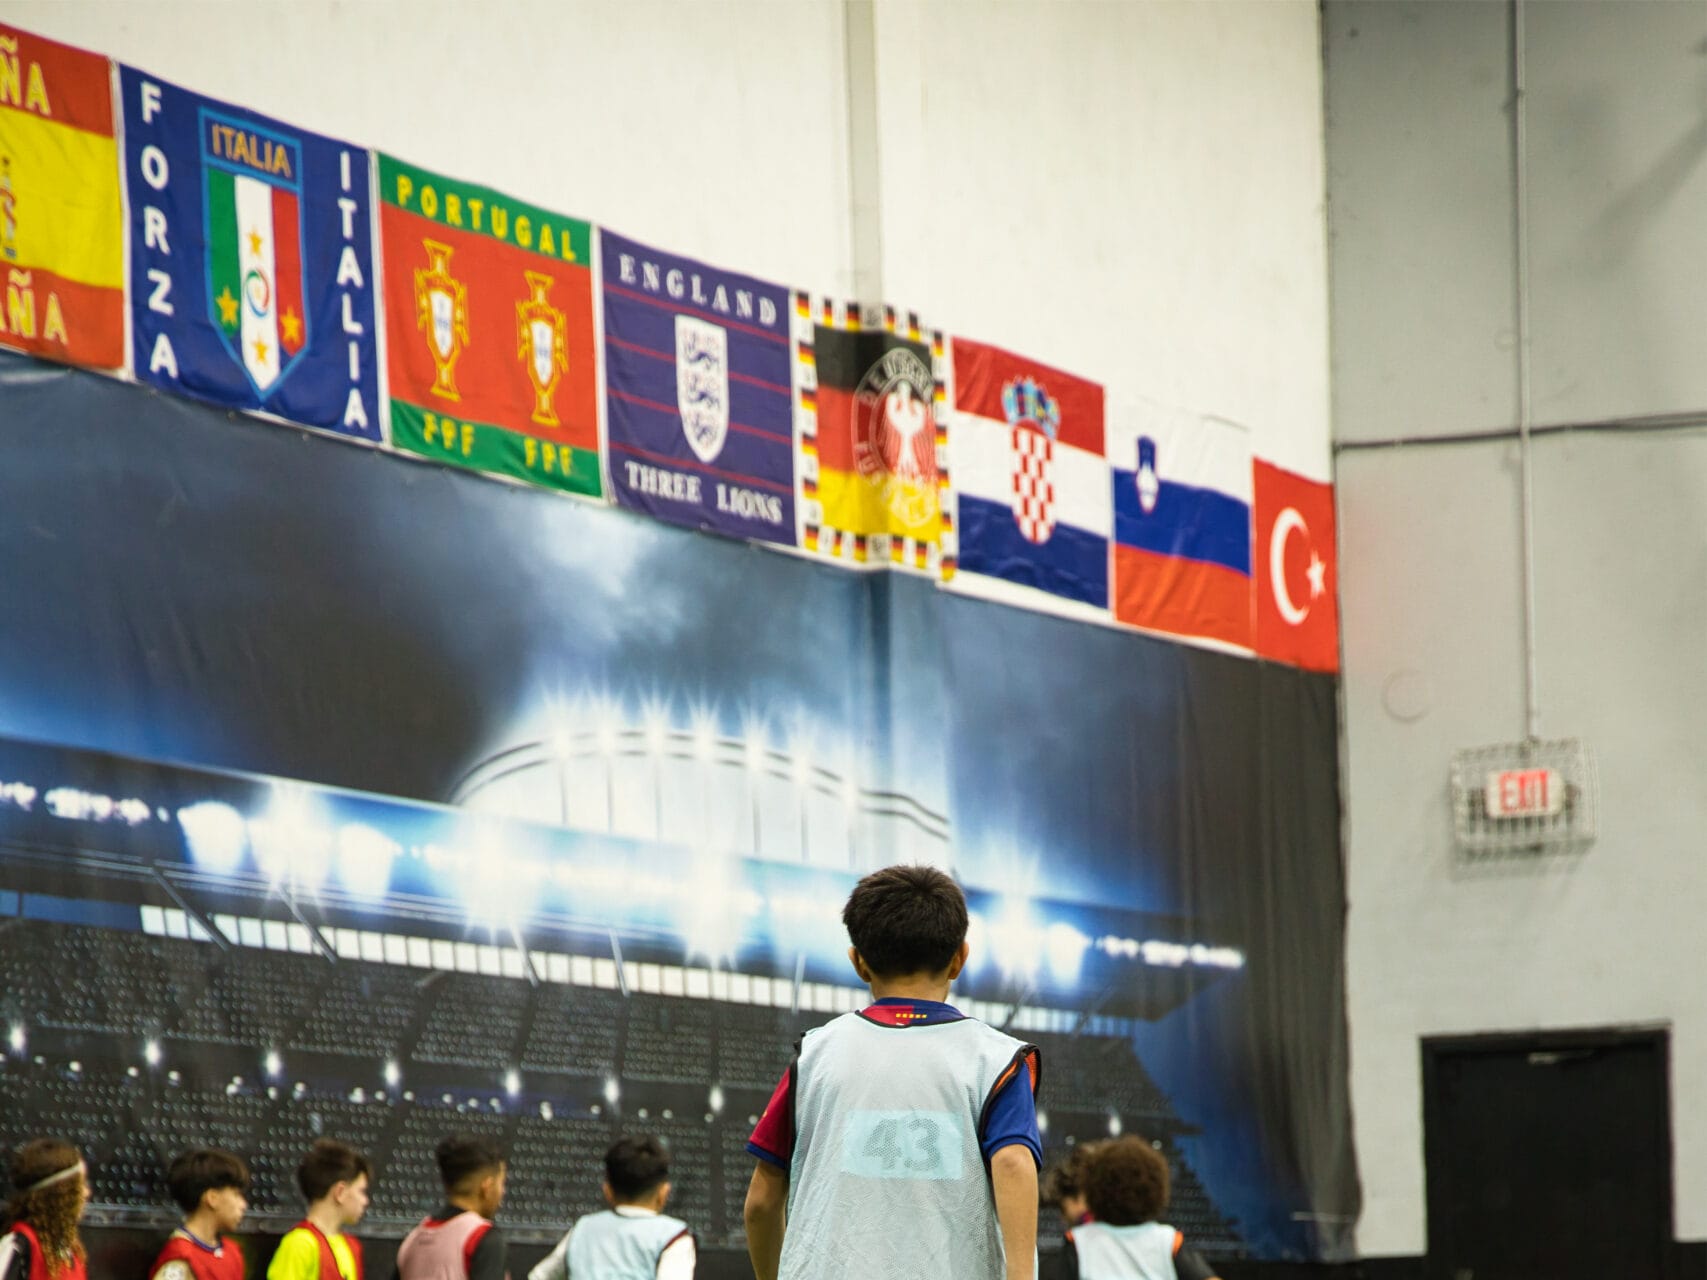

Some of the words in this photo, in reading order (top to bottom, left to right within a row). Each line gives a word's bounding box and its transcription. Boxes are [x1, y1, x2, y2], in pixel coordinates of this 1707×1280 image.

[212, 124, 292, 178] ITALIA
[140, 81, 179, 379] FORZA
[396, 174, 577, 262] PORTUGAL
[336, 150, 369, 429] ITALIA
[619, 253, 777, 327] ENGLAND
[624, 459, 702, 504] THREE
[716, 482, 783, 526] LIONS
[861, 1117, 942, 1171] 43
